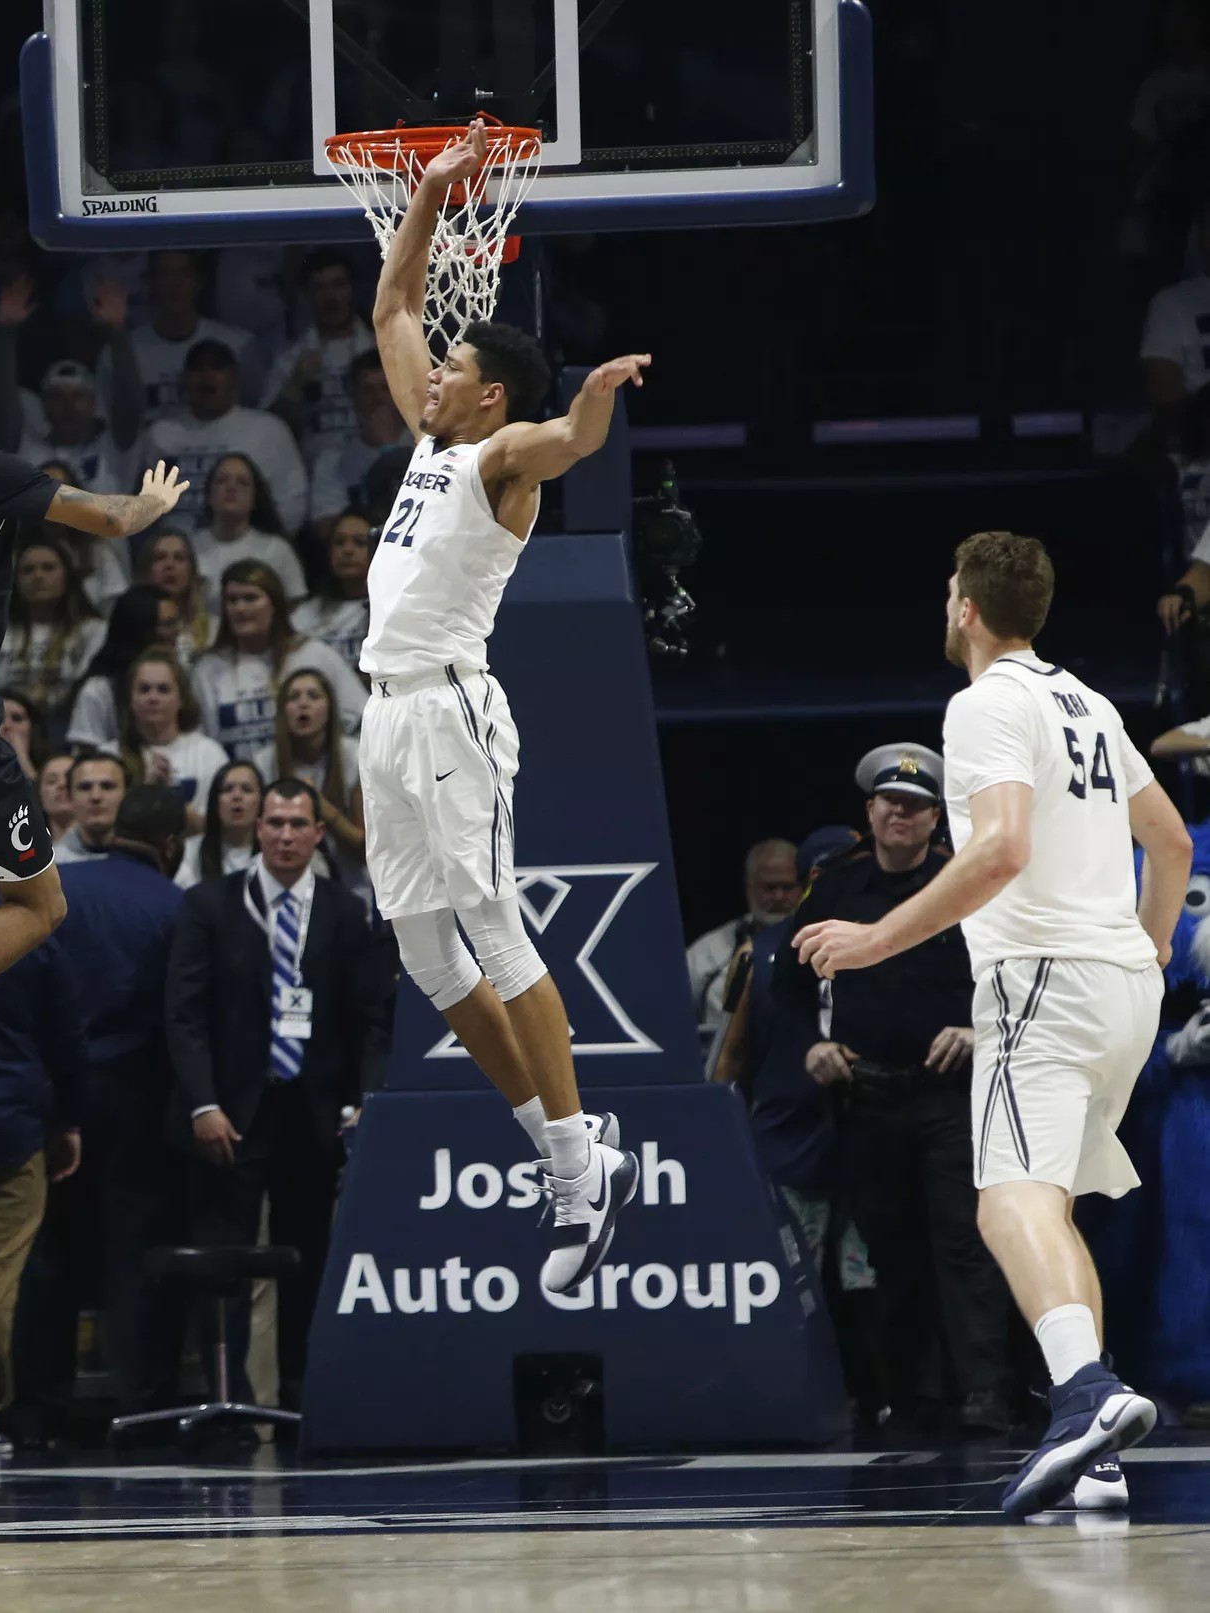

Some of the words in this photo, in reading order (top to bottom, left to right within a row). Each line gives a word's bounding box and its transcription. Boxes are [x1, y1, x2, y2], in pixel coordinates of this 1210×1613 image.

[82, 196, 158, 216] SPALDING
[1062, 726, 1118, 804] 54
[419, 1141, 686, 1210] Josh
[337, 1253, 520, 1315] Auto
